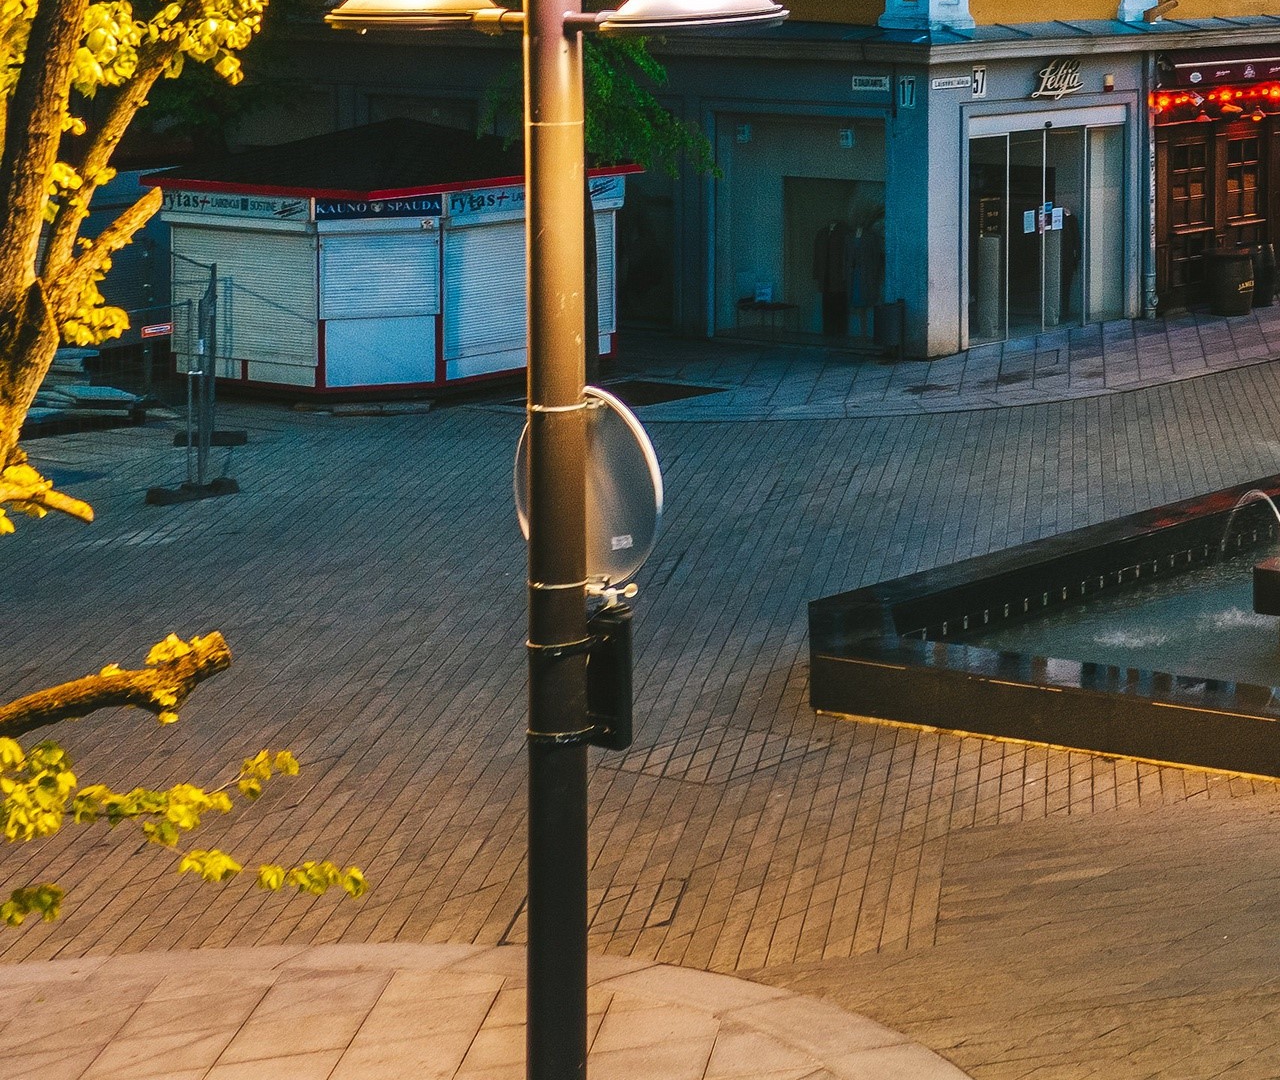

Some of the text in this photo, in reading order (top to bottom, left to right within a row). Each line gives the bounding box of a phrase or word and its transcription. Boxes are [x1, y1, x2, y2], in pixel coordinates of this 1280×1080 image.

[900, 79, 915, 106] 17
[972, 69, 986, 95] 57
[1031, 60, 1085, 100] Lelija
[316, 202, 367, 214] KAUNO
[387, 201, 440, 211] SPAUDA
